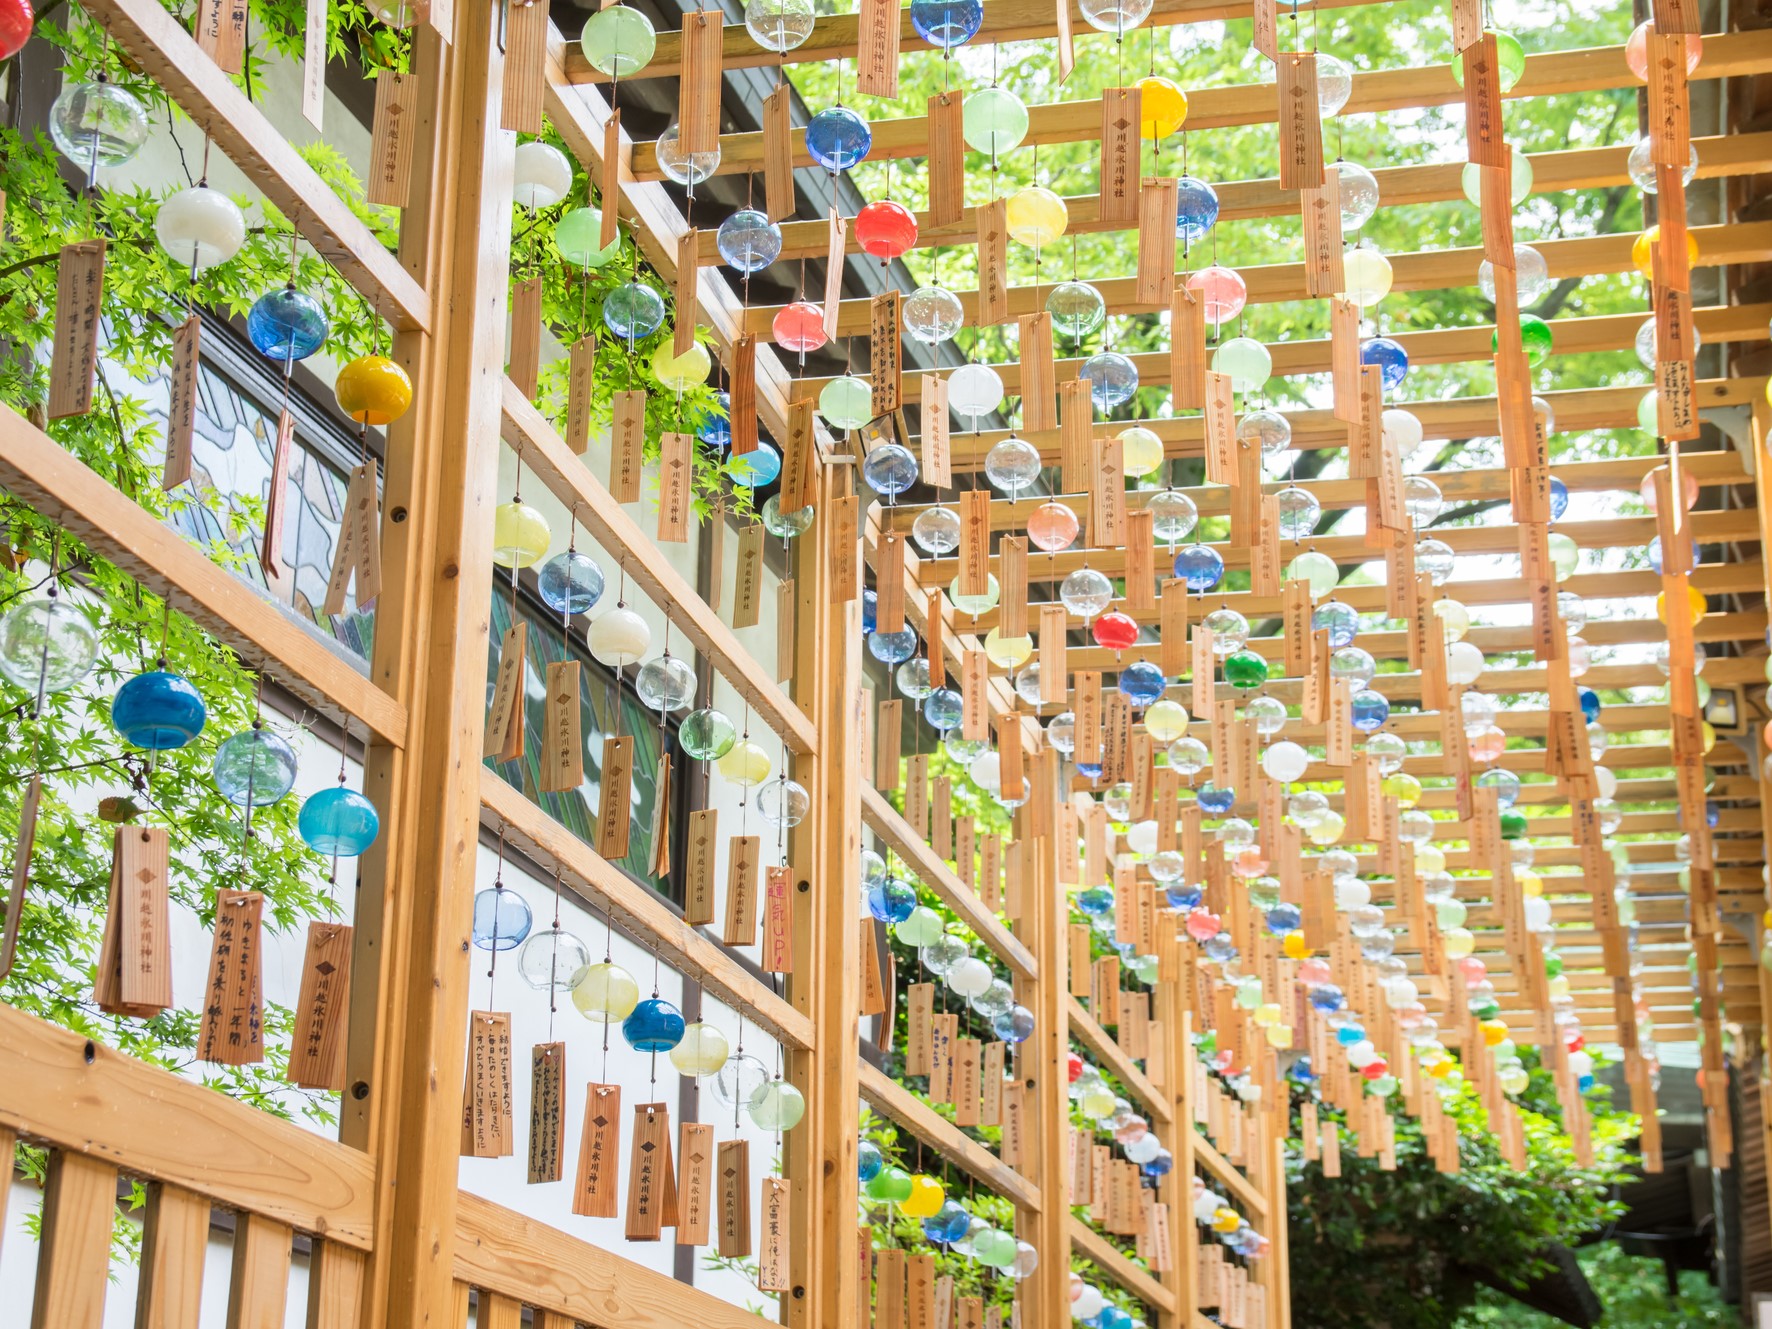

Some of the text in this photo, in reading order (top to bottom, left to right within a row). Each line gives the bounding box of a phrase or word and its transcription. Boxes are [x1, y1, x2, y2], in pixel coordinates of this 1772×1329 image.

[873, 8, 886, 73] 川越氷川神社
[1294, 100, 1306, 166] 川越氷川神社
[1663, 73, 1675, 141] 川越氷川神社
[387, 118, 399, 183] 川越氷川神社
[1113, 132, 1128, 199] 川越氷川神社
[1317, 212, 1330, 274] 川越氷川神社
[621, 430, 632, 484] 川越氷川神社
[671, 472, 681, 524] 川越氷川神社
[1105, 478, 1114, 529] 川越氷川神社
[743, 563, 752, 610] 川越氷川神社
[559, 708, 571, 769] 川越氷川神社
[606, 779, 619, 839] 川越氷川神社
[696, 849, 705, 903] 川越氷川神社
[736, 872, 745, 926] 川越氷川神社
[140, 889, 153, 974] 川越氷川神社
[307, 979, 330, 1057] 川越氷川神社
[587, 1131, 603, 1195] 川越氷川神社
[638, 1155, 652, 1215] 川越氷川神社
[690, 1166, 700, 1225] 川越氷川神社
[726, 1181, 734, 1237] 川越氷川神社
